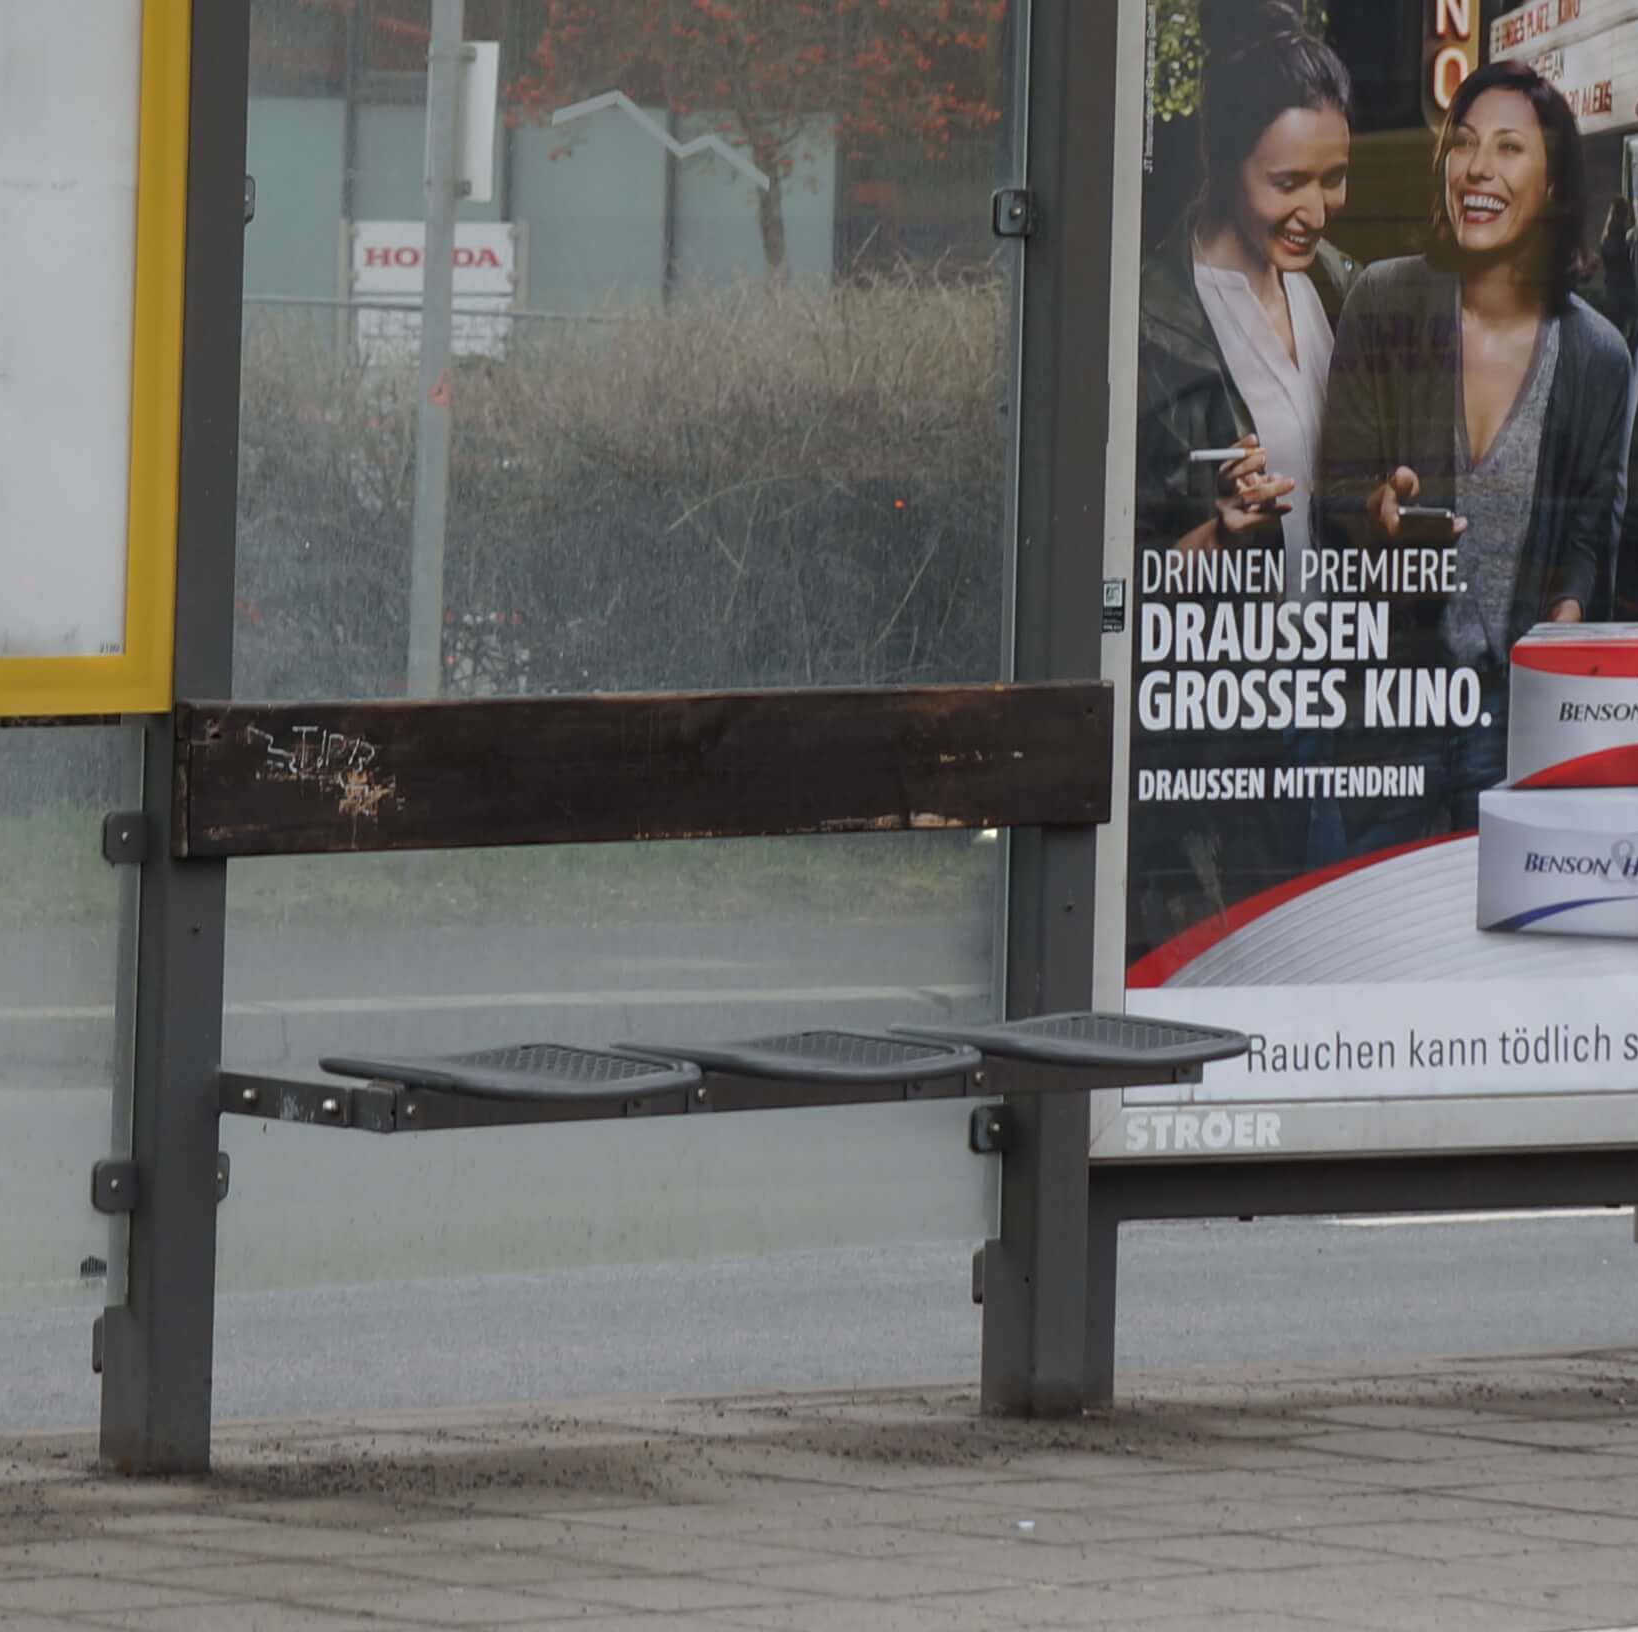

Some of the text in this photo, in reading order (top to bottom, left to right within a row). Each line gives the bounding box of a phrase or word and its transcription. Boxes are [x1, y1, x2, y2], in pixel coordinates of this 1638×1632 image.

[365, 246, 502, 268] HODA
[1141, 547, 1469, 595] DRINNEN PREMIERE.
[1140, 600, 1390, 663] DRAUSSEN
[1138, 667, 1493, 731] GROSSES KINO.
[1138, 765, 1426, 801] DRAUSSEN MITTENDRIN
[1524, 852, 1621, 877] BENSON
[1247, 1030, 1396, 1072] Rauchen
[1408, 1028, 1488, 1067] kann
[1498, 1024, 1612, 1065] tödlich
[1126, 1108, 1282, 1151] STRÖER
